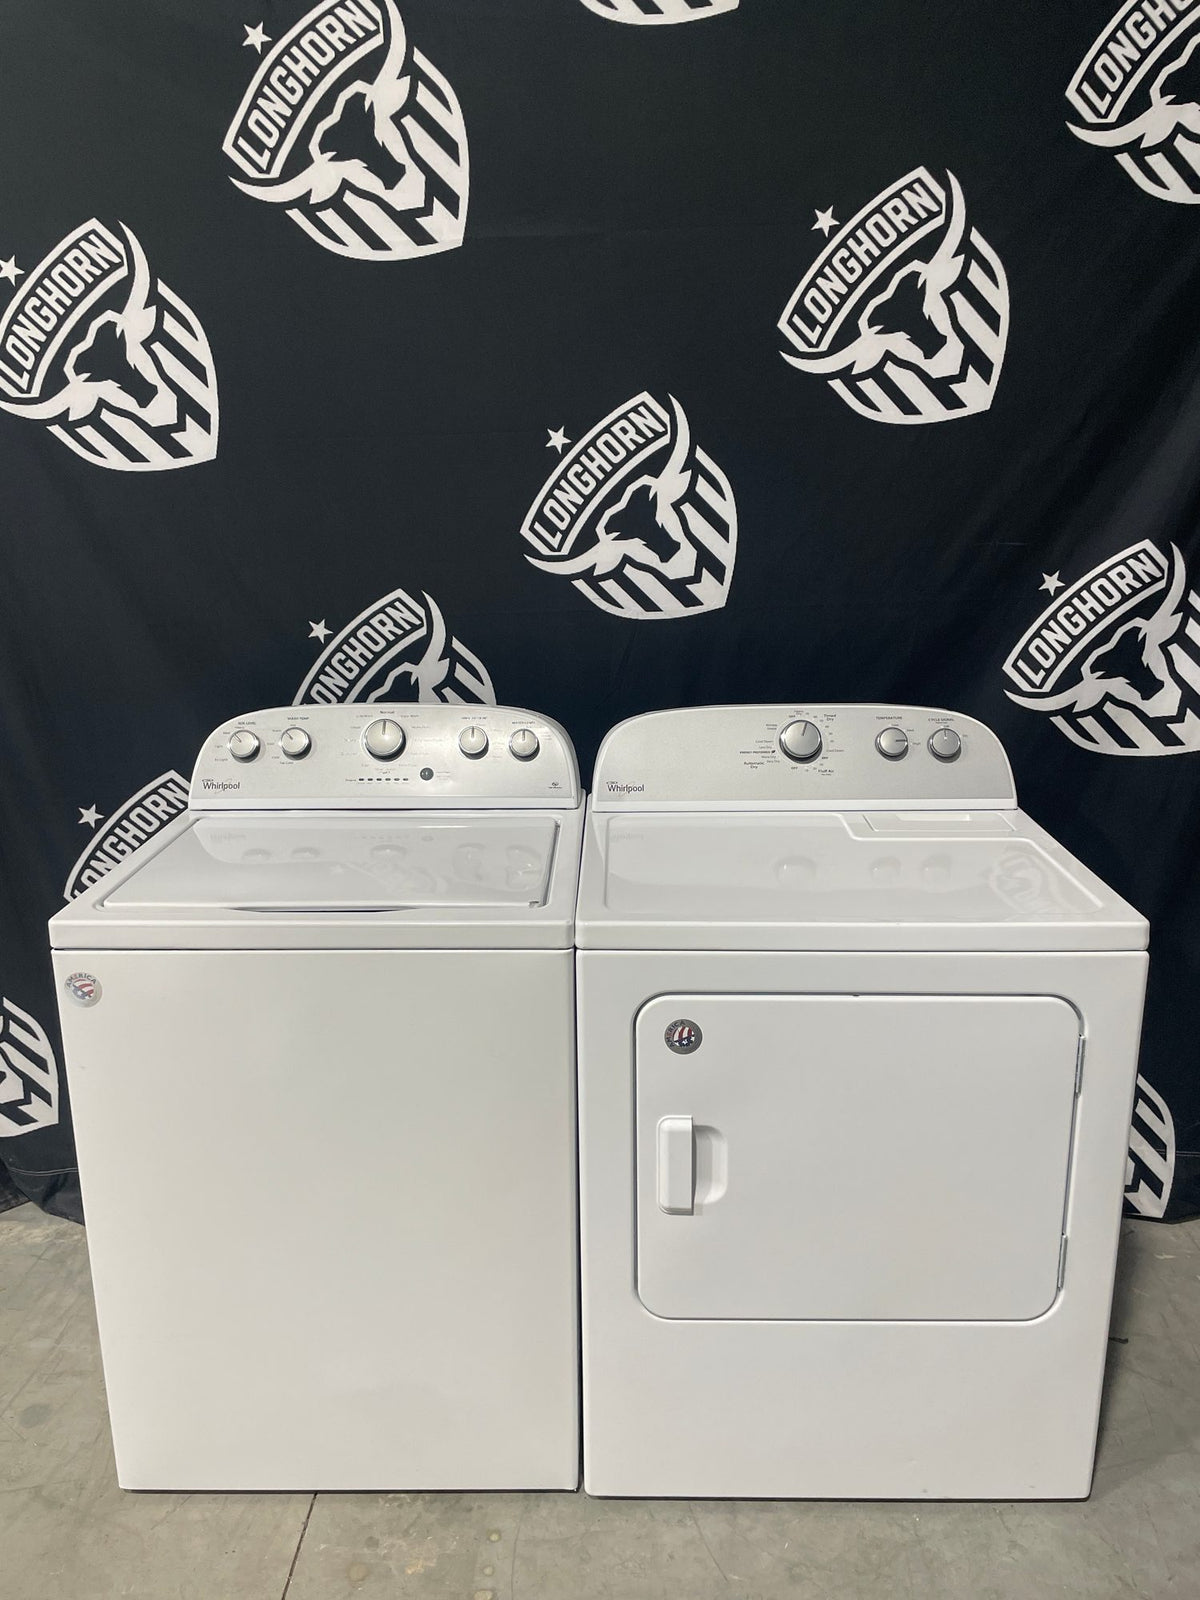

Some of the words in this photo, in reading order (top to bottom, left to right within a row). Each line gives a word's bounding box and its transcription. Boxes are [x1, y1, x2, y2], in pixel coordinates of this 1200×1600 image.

[237, 0, 378, 171] LONGHORN
[1080, 0, 1194, 116] LONGH
[0, 233, 122, 391] LONGHORN
[791, 182, 941, 345] LONGHORN
[533, 405, 666, 550] LONGHORN
[304, 601, 422, 704] ONGHORN
[1016, 552, 1163, 687] LONGHORN
[74, 781, 189, 895] ONGHORN
[202, 782, 241, 792] Whirlpool
[607, 784, 645, 794] Whirlpool
[66, 972, 97, 988] AMERICA
